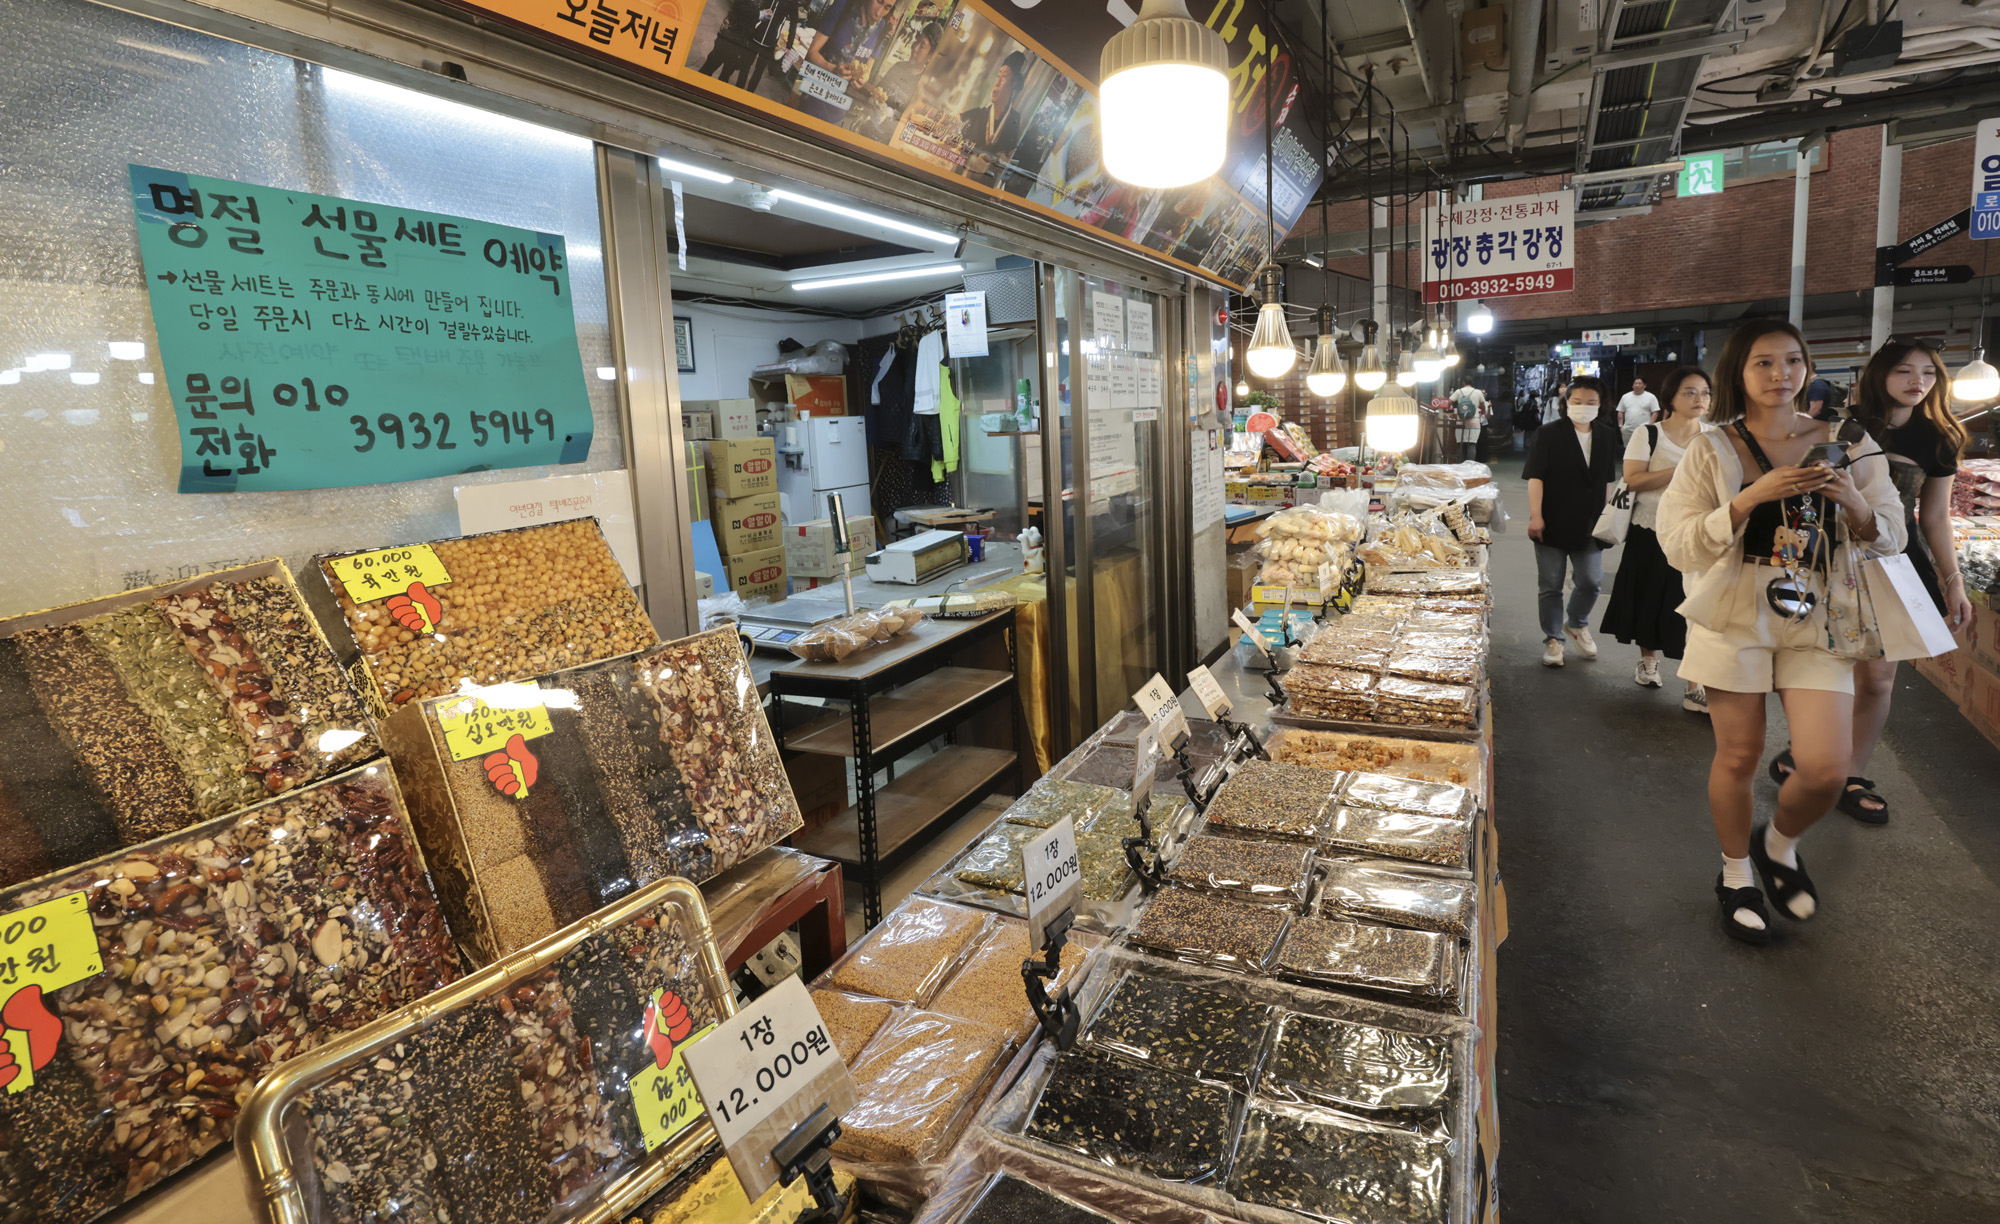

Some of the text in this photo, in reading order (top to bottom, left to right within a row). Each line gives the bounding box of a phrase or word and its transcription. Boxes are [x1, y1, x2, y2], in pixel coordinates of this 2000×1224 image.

[557, 0, 678, 65] 오늘저녁
[148, 182, 264, 255] 명절
[483, 238, 563, 297] 예약
[1913, 240, 1932, 254] Coffee
[1936, 226, 1960, 241] Cocktail
[1546, 261, 1562, 269] 67-1
[308, 277, 361, 302] 주문과
[366, 283, 414, 305] 동시에
[1439, 273, 1555, 299] 010-3932-5949
[189, 302, 239, 332] 당일
[253, 304, 311, 332] 주문시
[332, 311, 370, 332] 다소
[378, 312, 429, 335] 시간이
[184, 372, 349, 420] 문의 010
[189, 407, 555, 477] 전화 3932 5949
[1149, 688, 1162, 702] 1장
[1044, 837, 1060, 861] 1장
[1029, 852, 1078, 904] 12.000원
[739, 1014, 775, 1052] 1장
[716, 1024, 831, 1123] 12.000원
